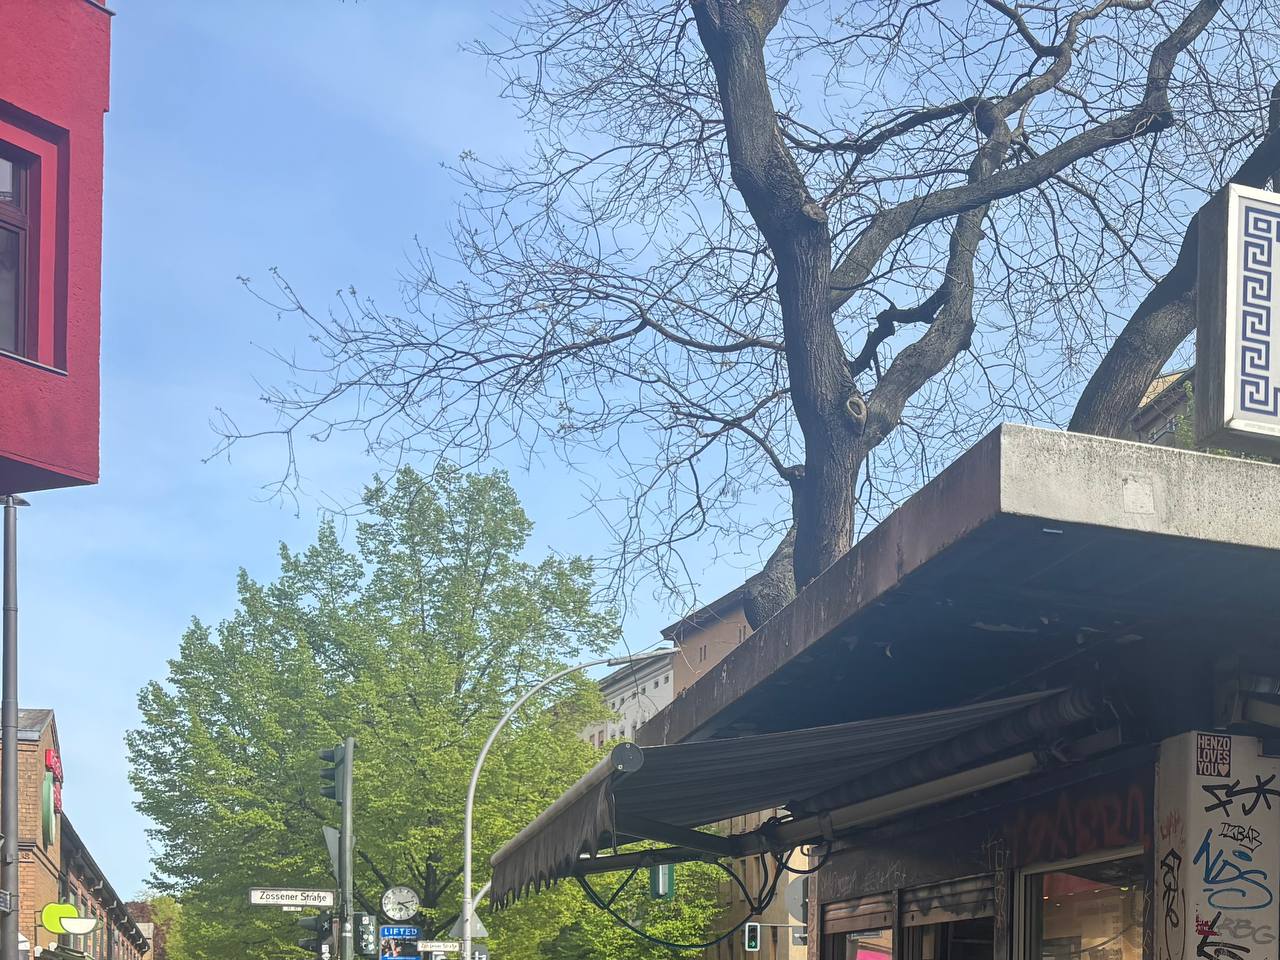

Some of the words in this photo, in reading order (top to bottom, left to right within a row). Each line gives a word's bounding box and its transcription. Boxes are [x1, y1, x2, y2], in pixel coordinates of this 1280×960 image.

[1197, 735, 1231, 751] HENZO
[1197, 749, 1230, 764] LOVES
[1197, 762, 1219, 776] YOU
[260, 891, 299, 900] Zossener
[300, 892, 328, 903] Straße
